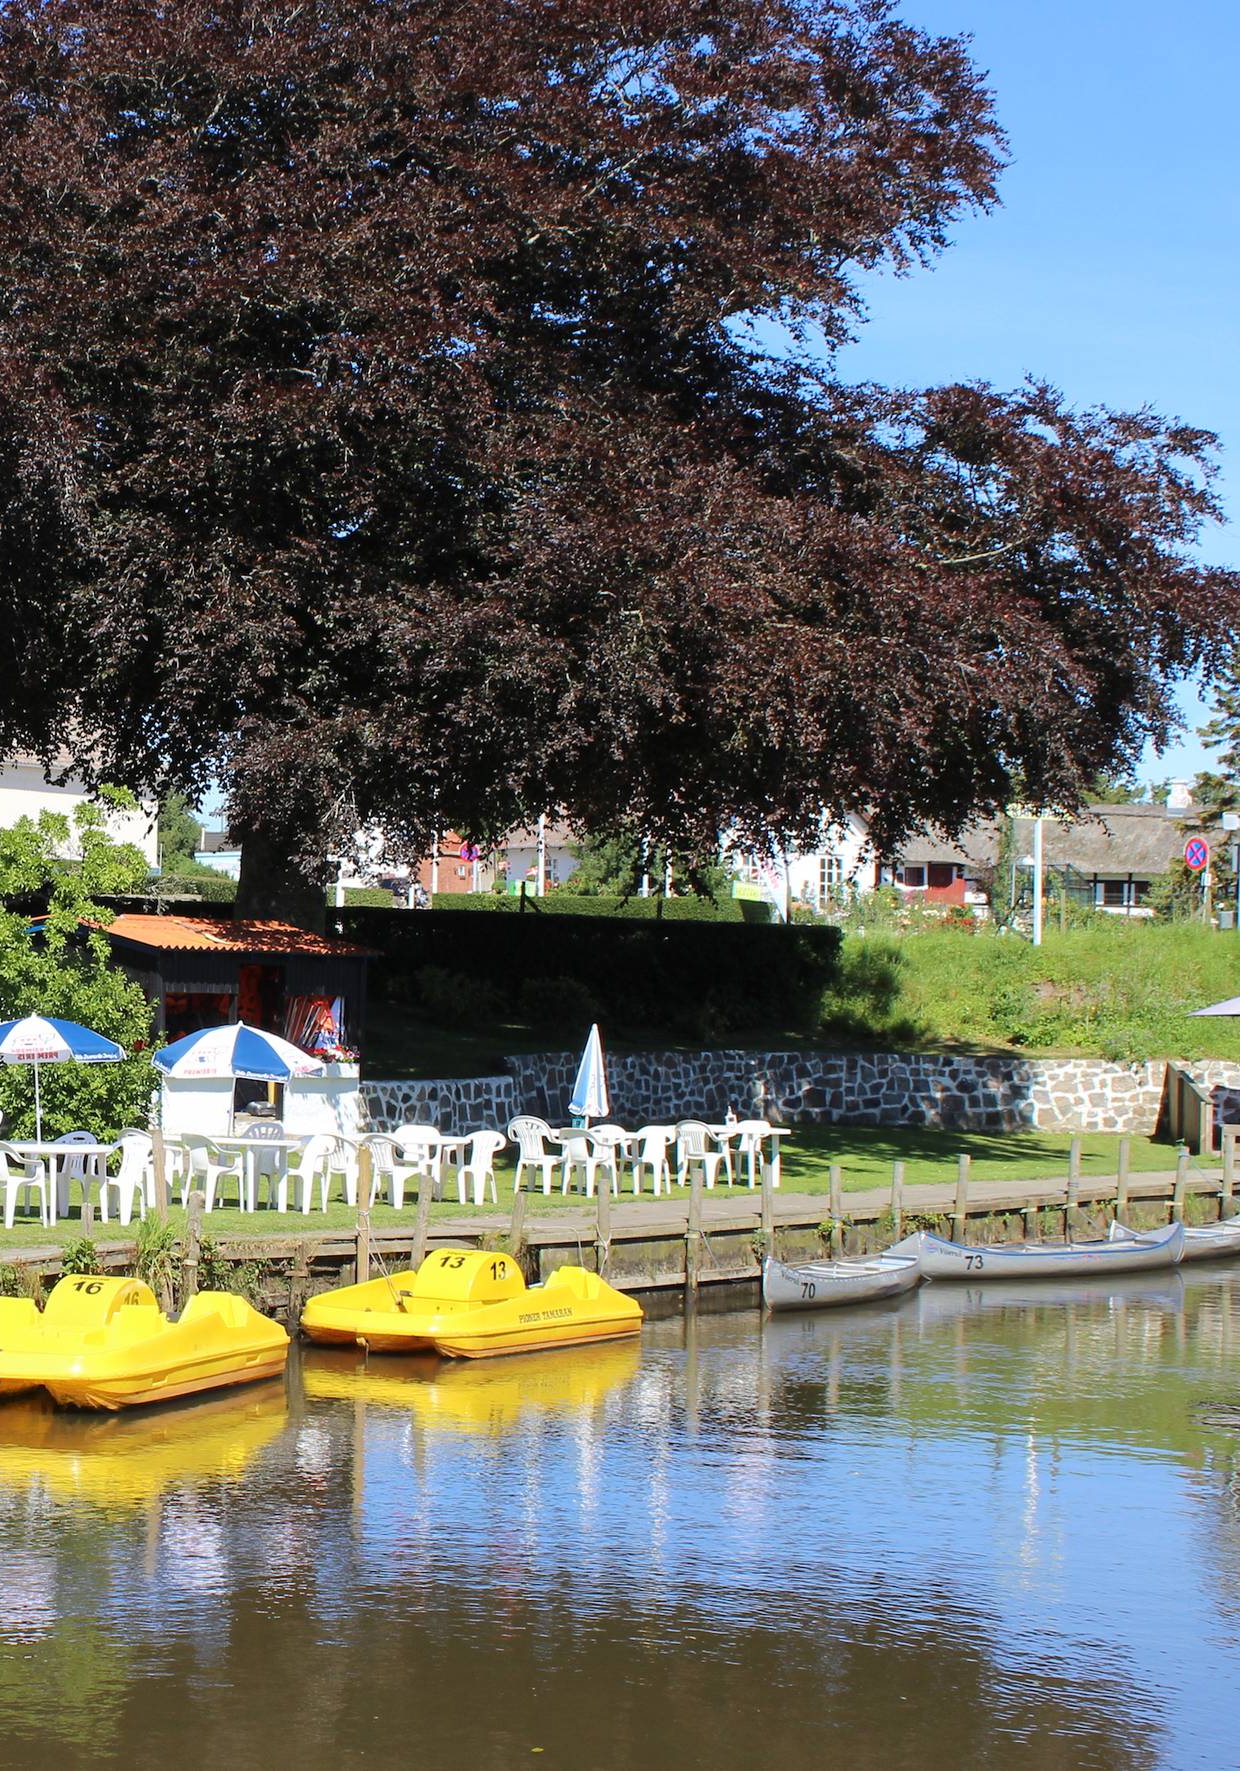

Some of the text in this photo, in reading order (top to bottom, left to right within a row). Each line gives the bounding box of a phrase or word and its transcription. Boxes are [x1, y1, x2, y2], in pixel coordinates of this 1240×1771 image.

[440, 1256, 465, 1269] 13
[965, 1255, 984, 1270] 73
[490, 1261, 506, 1281] 13
[73, 1281, 104, 1295] 16
[801, 1282, 816, 1299] 70
